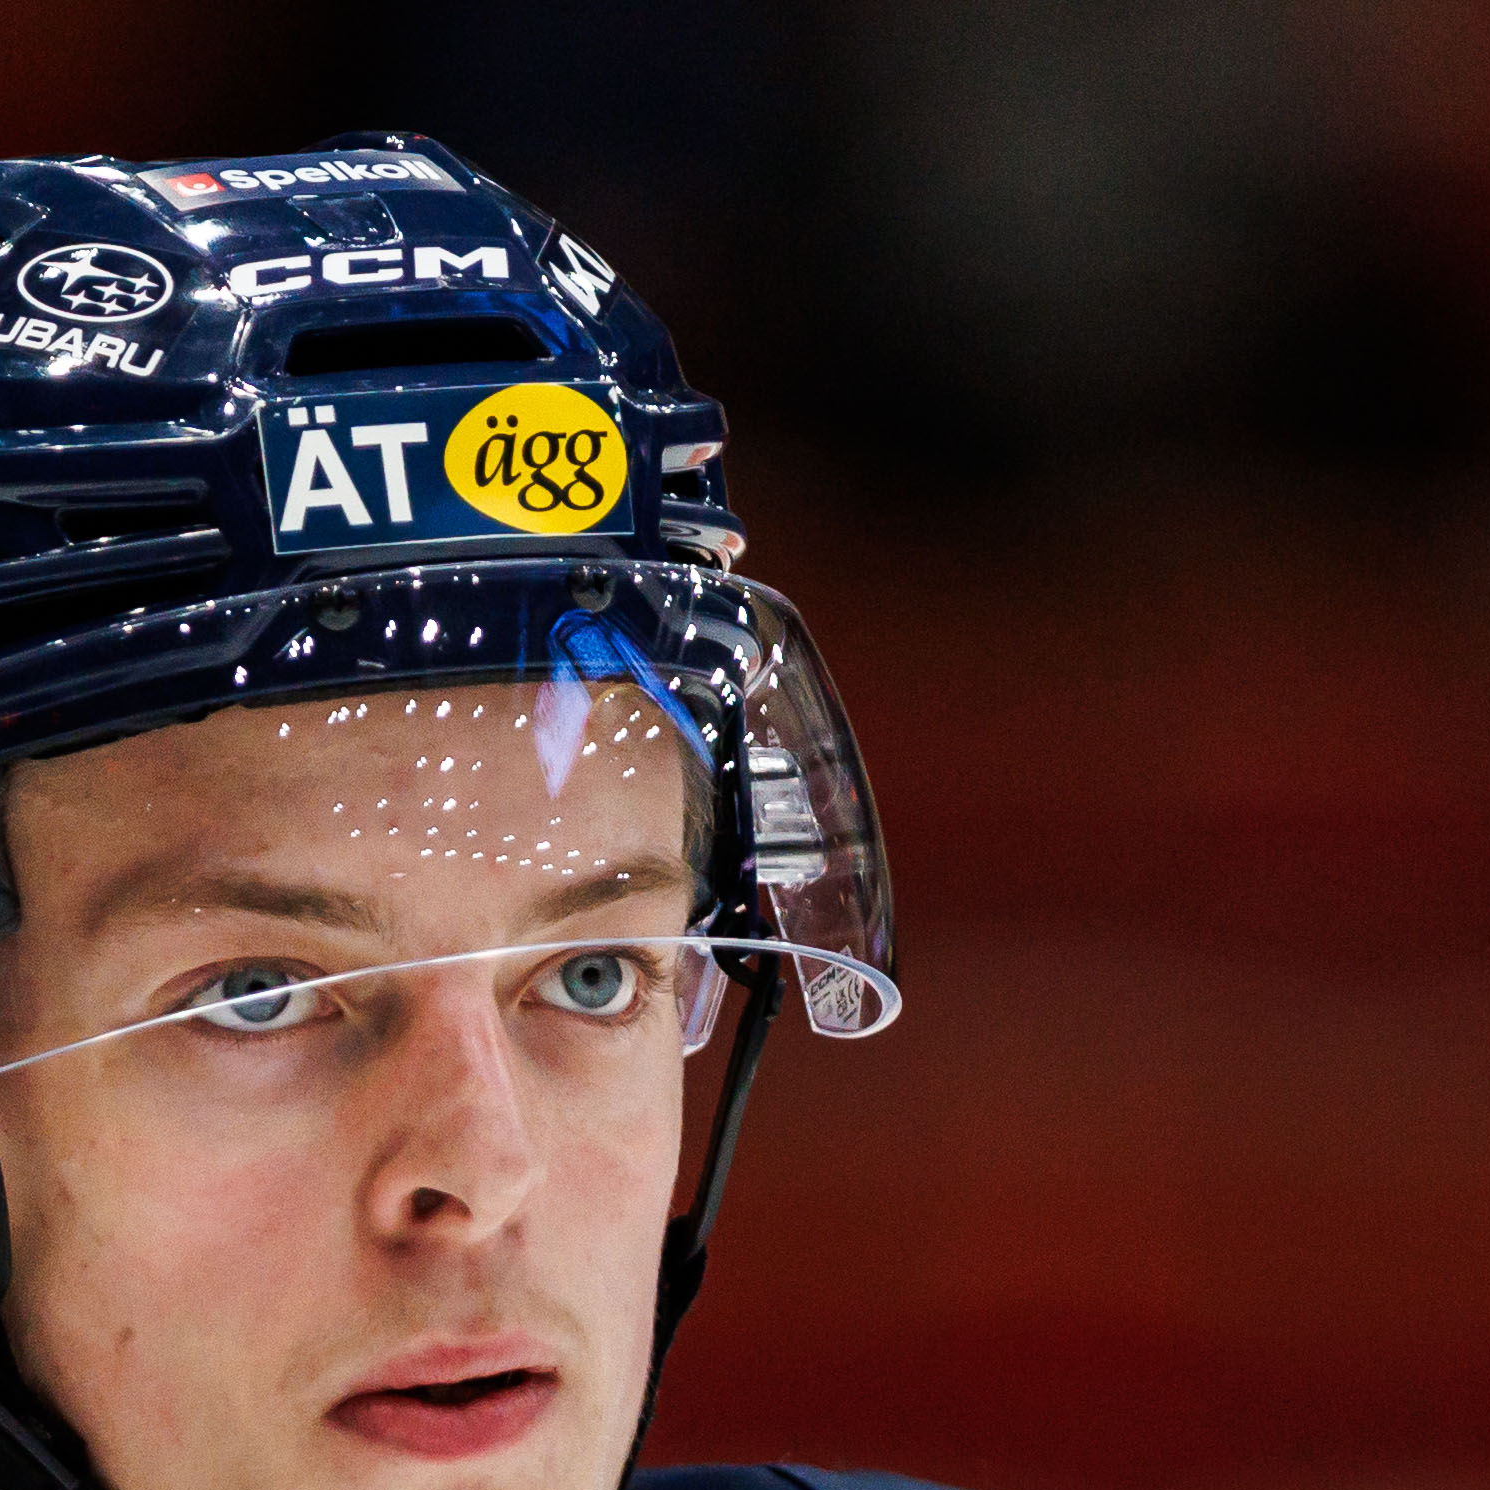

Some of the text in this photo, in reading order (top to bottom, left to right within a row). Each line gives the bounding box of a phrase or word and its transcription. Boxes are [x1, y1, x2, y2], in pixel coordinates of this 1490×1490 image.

[220, 160, 441, 190] Spelkoll
[229, 246, 509, 297] CCM
[279, 405, 608, 532] ÄT ägg
